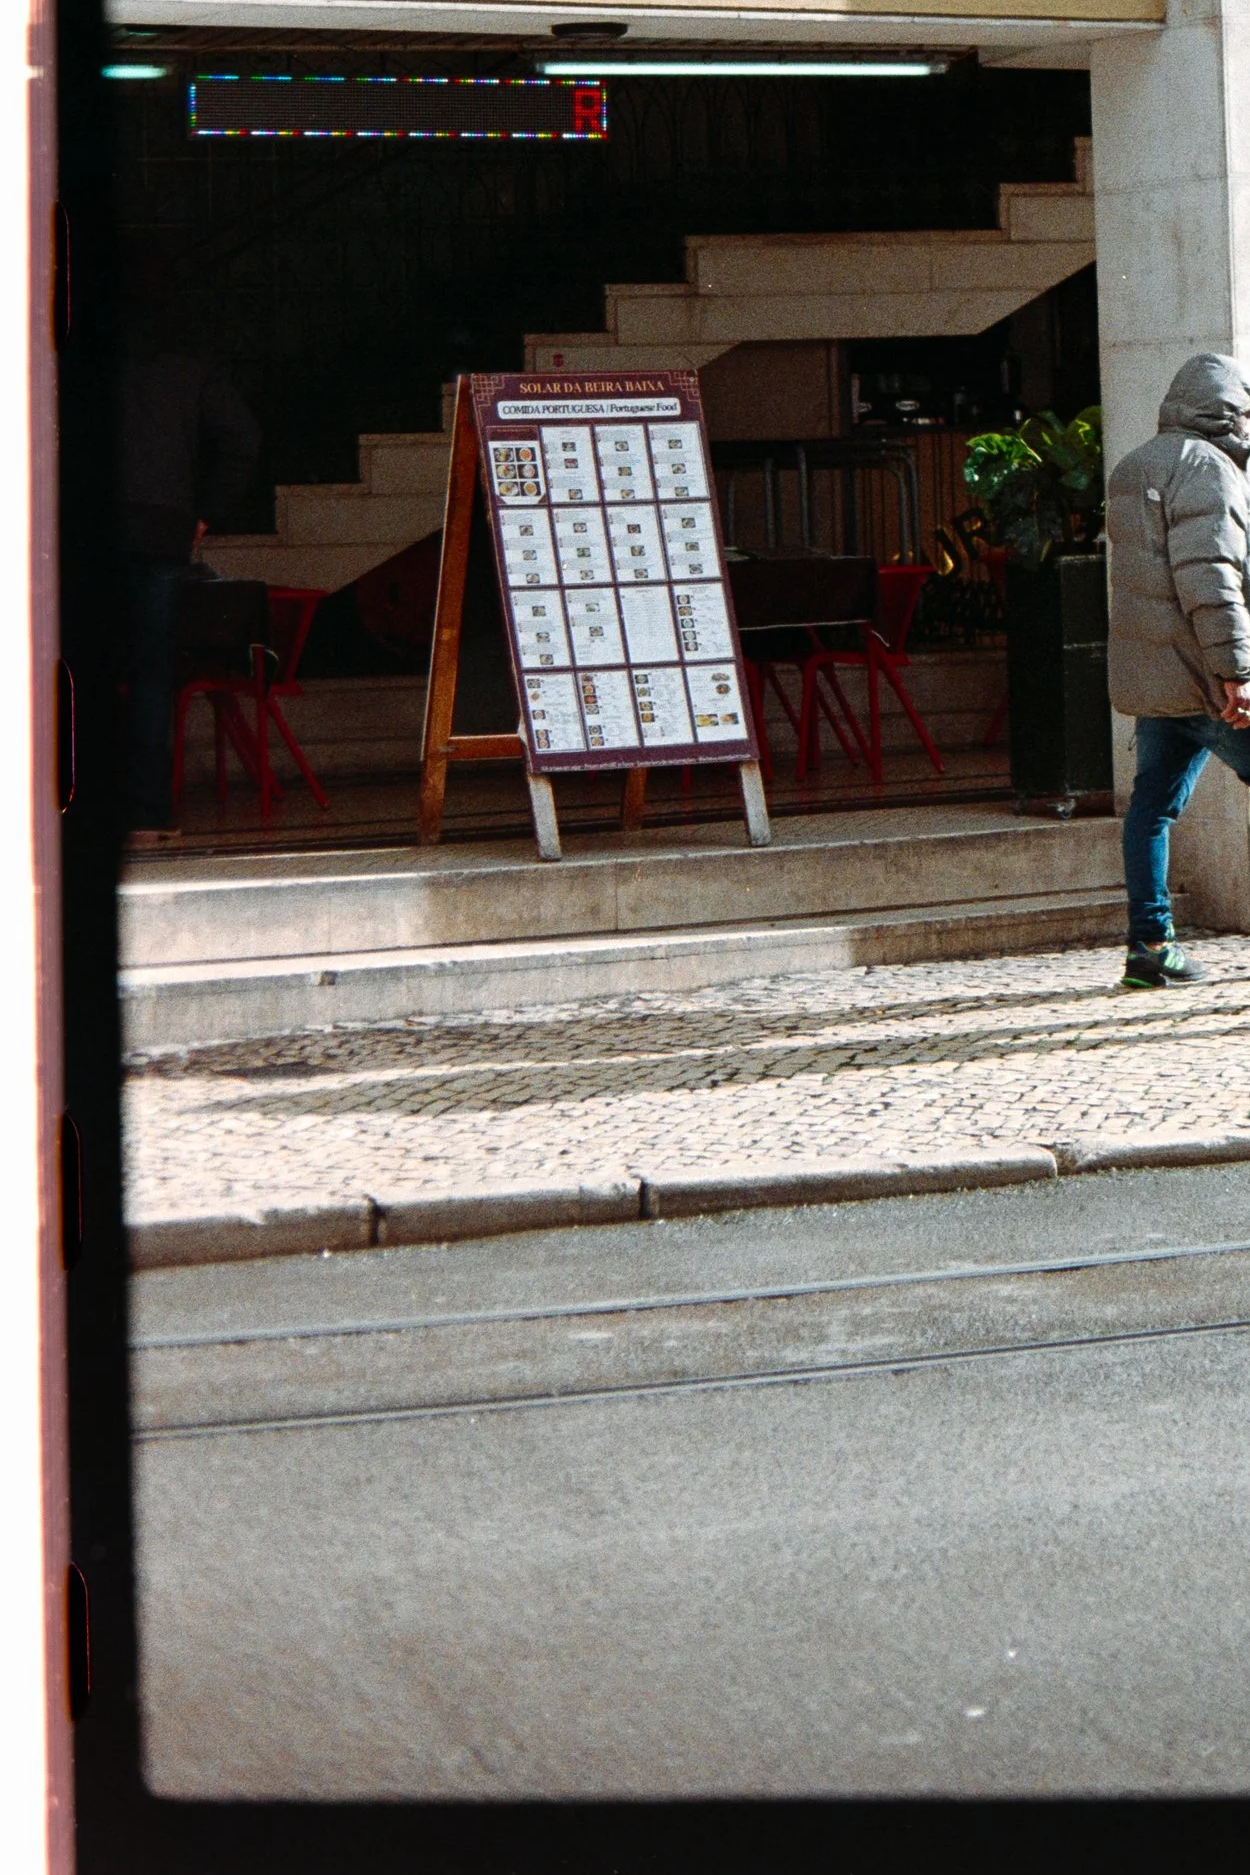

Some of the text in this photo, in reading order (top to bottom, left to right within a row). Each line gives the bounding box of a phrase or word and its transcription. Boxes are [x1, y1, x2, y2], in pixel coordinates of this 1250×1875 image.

[575, 89, 601, 132] R
[519, 380, 665, 394] SOLAR DA BEIRA BAIXA
[502, 404, 542, 415] COMIDA
[542, 403, 605, 415] PORTUGUESA
[610, 403, 655, 415] Portuguese
[656, 402, 678, 413] Food
